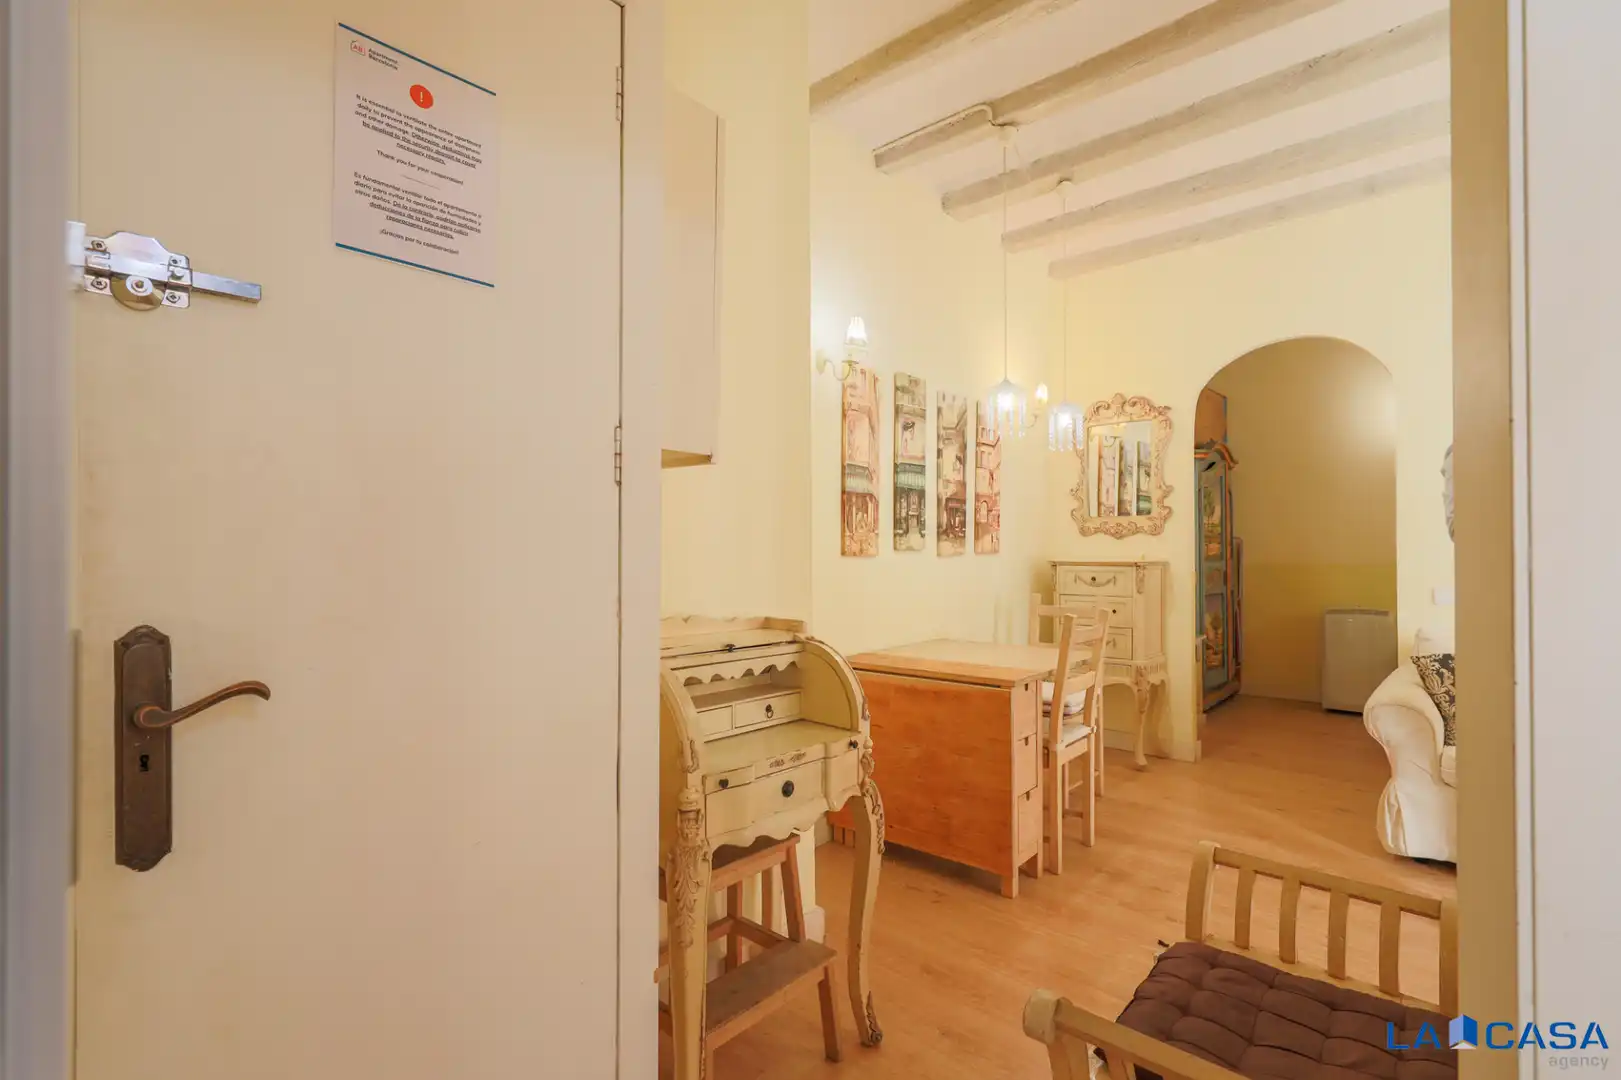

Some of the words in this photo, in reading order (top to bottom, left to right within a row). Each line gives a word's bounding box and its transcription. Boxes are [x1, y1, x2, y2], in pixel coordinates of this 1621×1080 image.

[357, 102, 372, 113] daily
[381, 112, 402, 125] prevent
[414, 126, 446, 143] appearance
[368, 114, 384, 125] other
[368, 99, 395, 114] essential
[403, 113, 427, 127] ventilate
[454, 134, 481, 149] apartment
[377, 149, 395, 161] Thank
[417, 165, 429, 174] your
[354, 180, 371, 190] diario
[373, 187, 387, 196] para
[388, 191, 404, 201] evitar
[355, 189, 370, 198] otros
[362, 174, 400, 192] fundamental
[424, 195, 436, 204] todo
